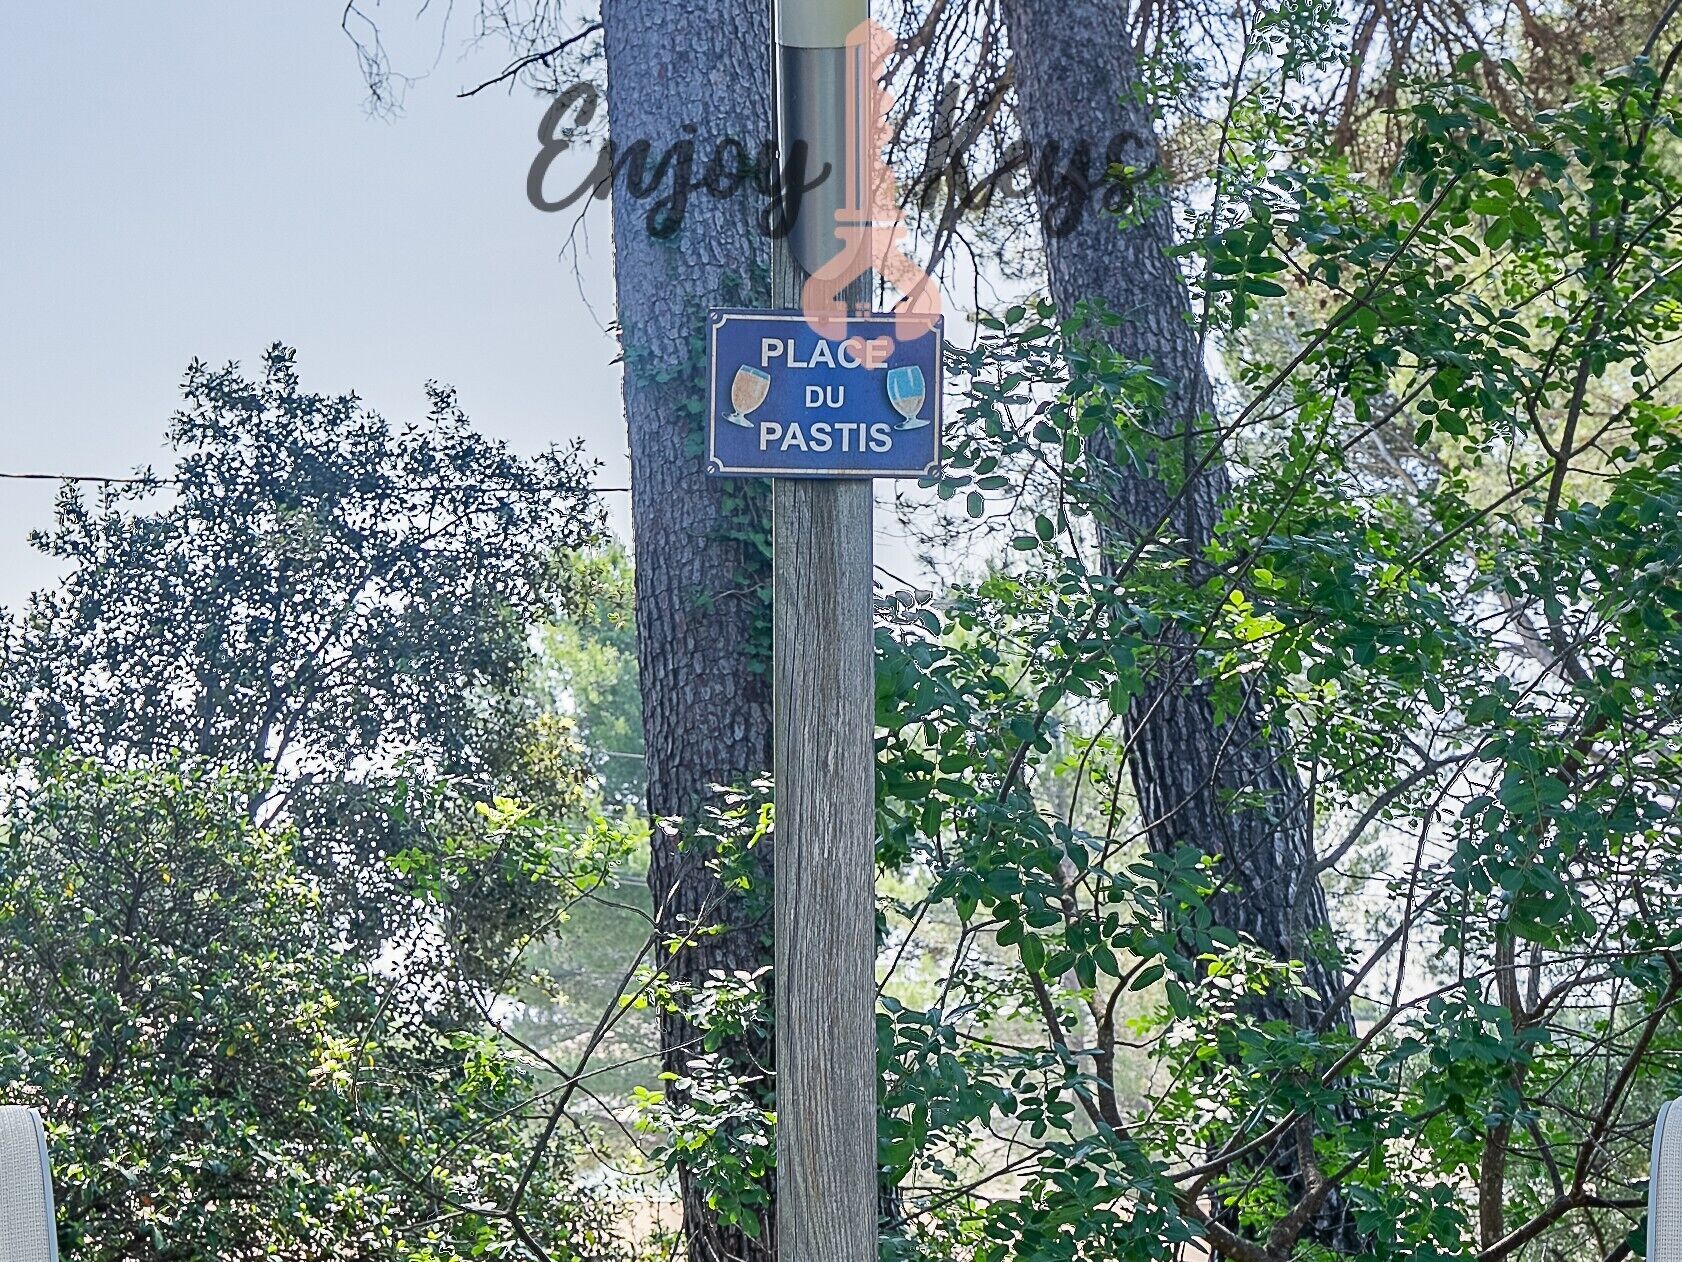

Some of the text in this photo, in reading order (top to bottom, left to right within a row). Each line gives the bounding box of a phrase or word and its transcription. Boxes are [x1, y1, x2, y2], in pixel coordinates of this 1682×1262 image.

[761, 338, 889, 369] PLACE
[805, 385, 845, 409] DU
[759, 421, 893, 453] PASTIS
